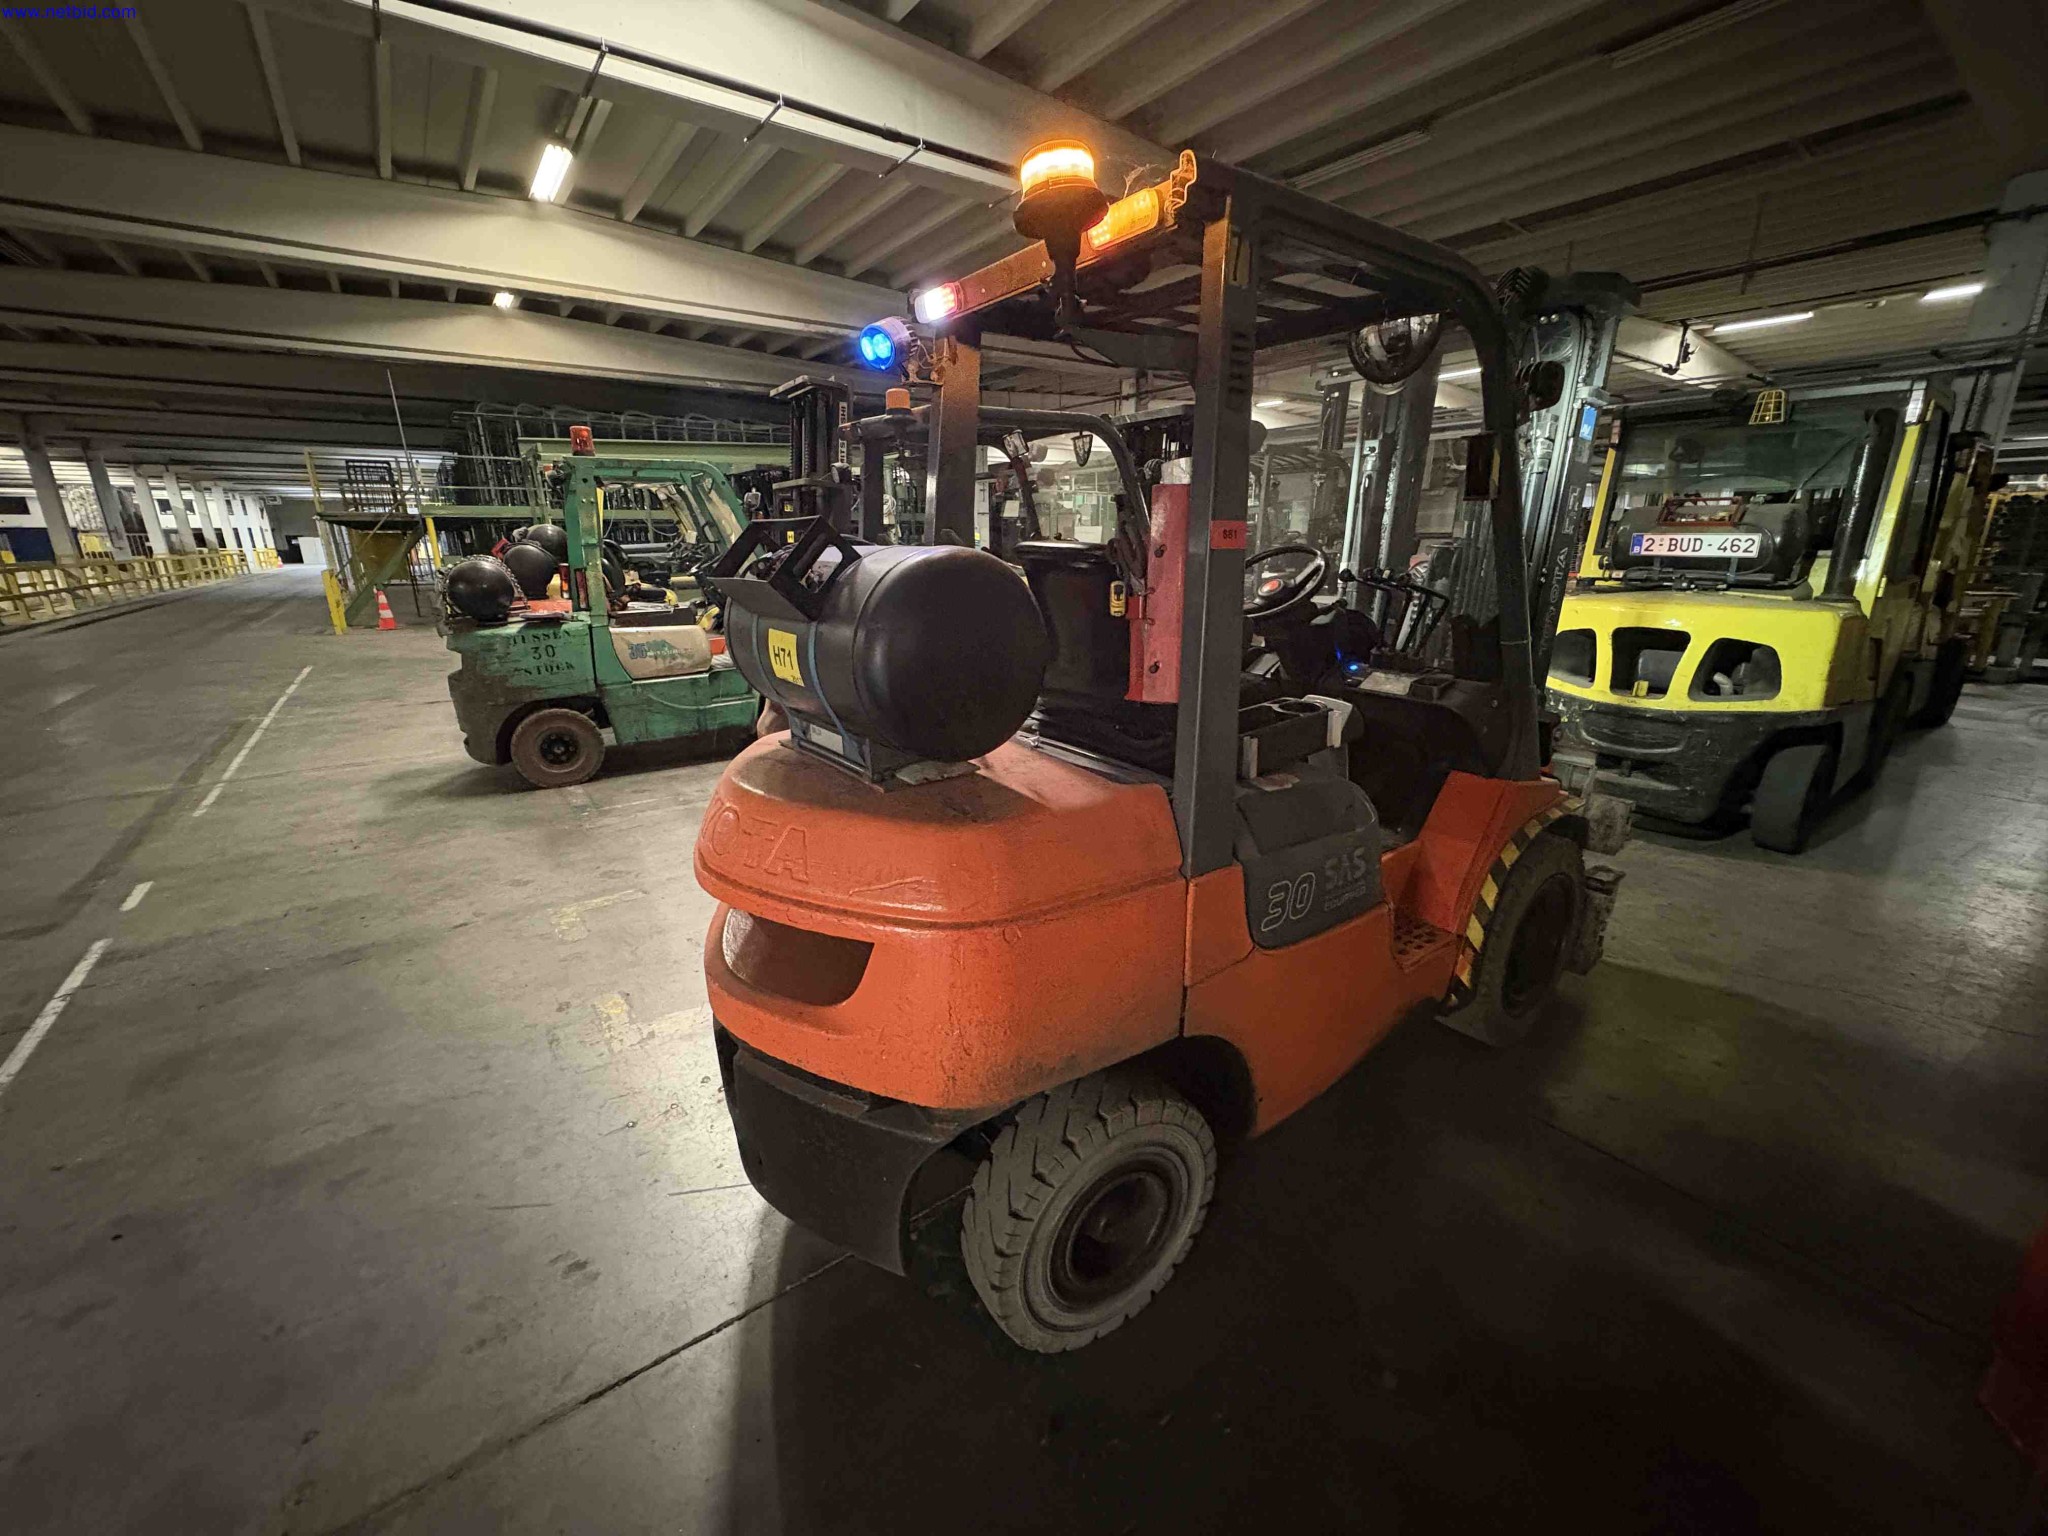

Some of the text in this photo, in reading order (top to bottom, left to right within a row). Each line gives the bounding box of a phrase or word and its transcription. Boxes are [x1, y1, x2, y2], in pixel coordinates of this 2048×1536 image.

[530, 644, 556, 660] 30
[771, 645, 795, 671] H71
[1324, 846, 1367, 891] SAS
[1261, 871, 1317, 932] 30
